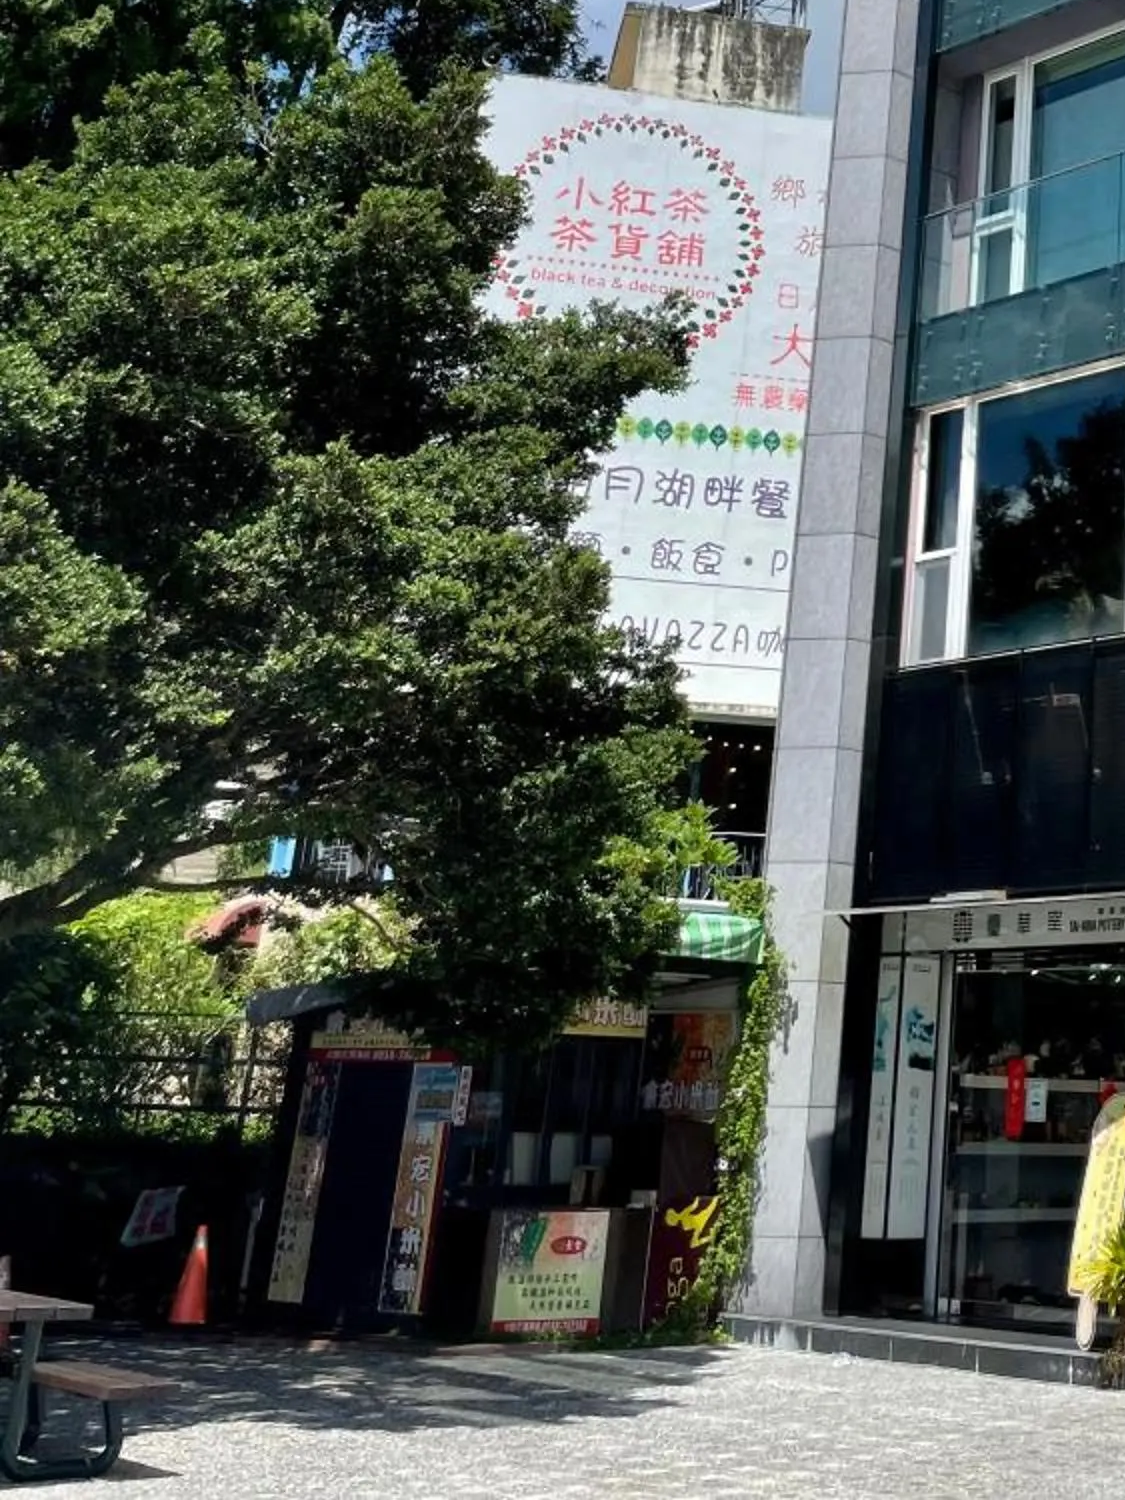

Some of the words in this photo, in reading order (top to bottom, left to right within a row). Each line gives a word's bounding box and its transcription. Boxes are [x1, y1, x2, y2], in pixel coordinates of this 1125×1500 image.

[556, 176, 709, 224] 小紅茶
[772, 175, 826, 209] 鄉
[550, 215, 707, 268] 茶貨舖
[530, 267, 576, 285] black
[581, 273, 606, 289] tea
[611, 276, 623, 290] &
[629, 280, 716, 301] decortion
